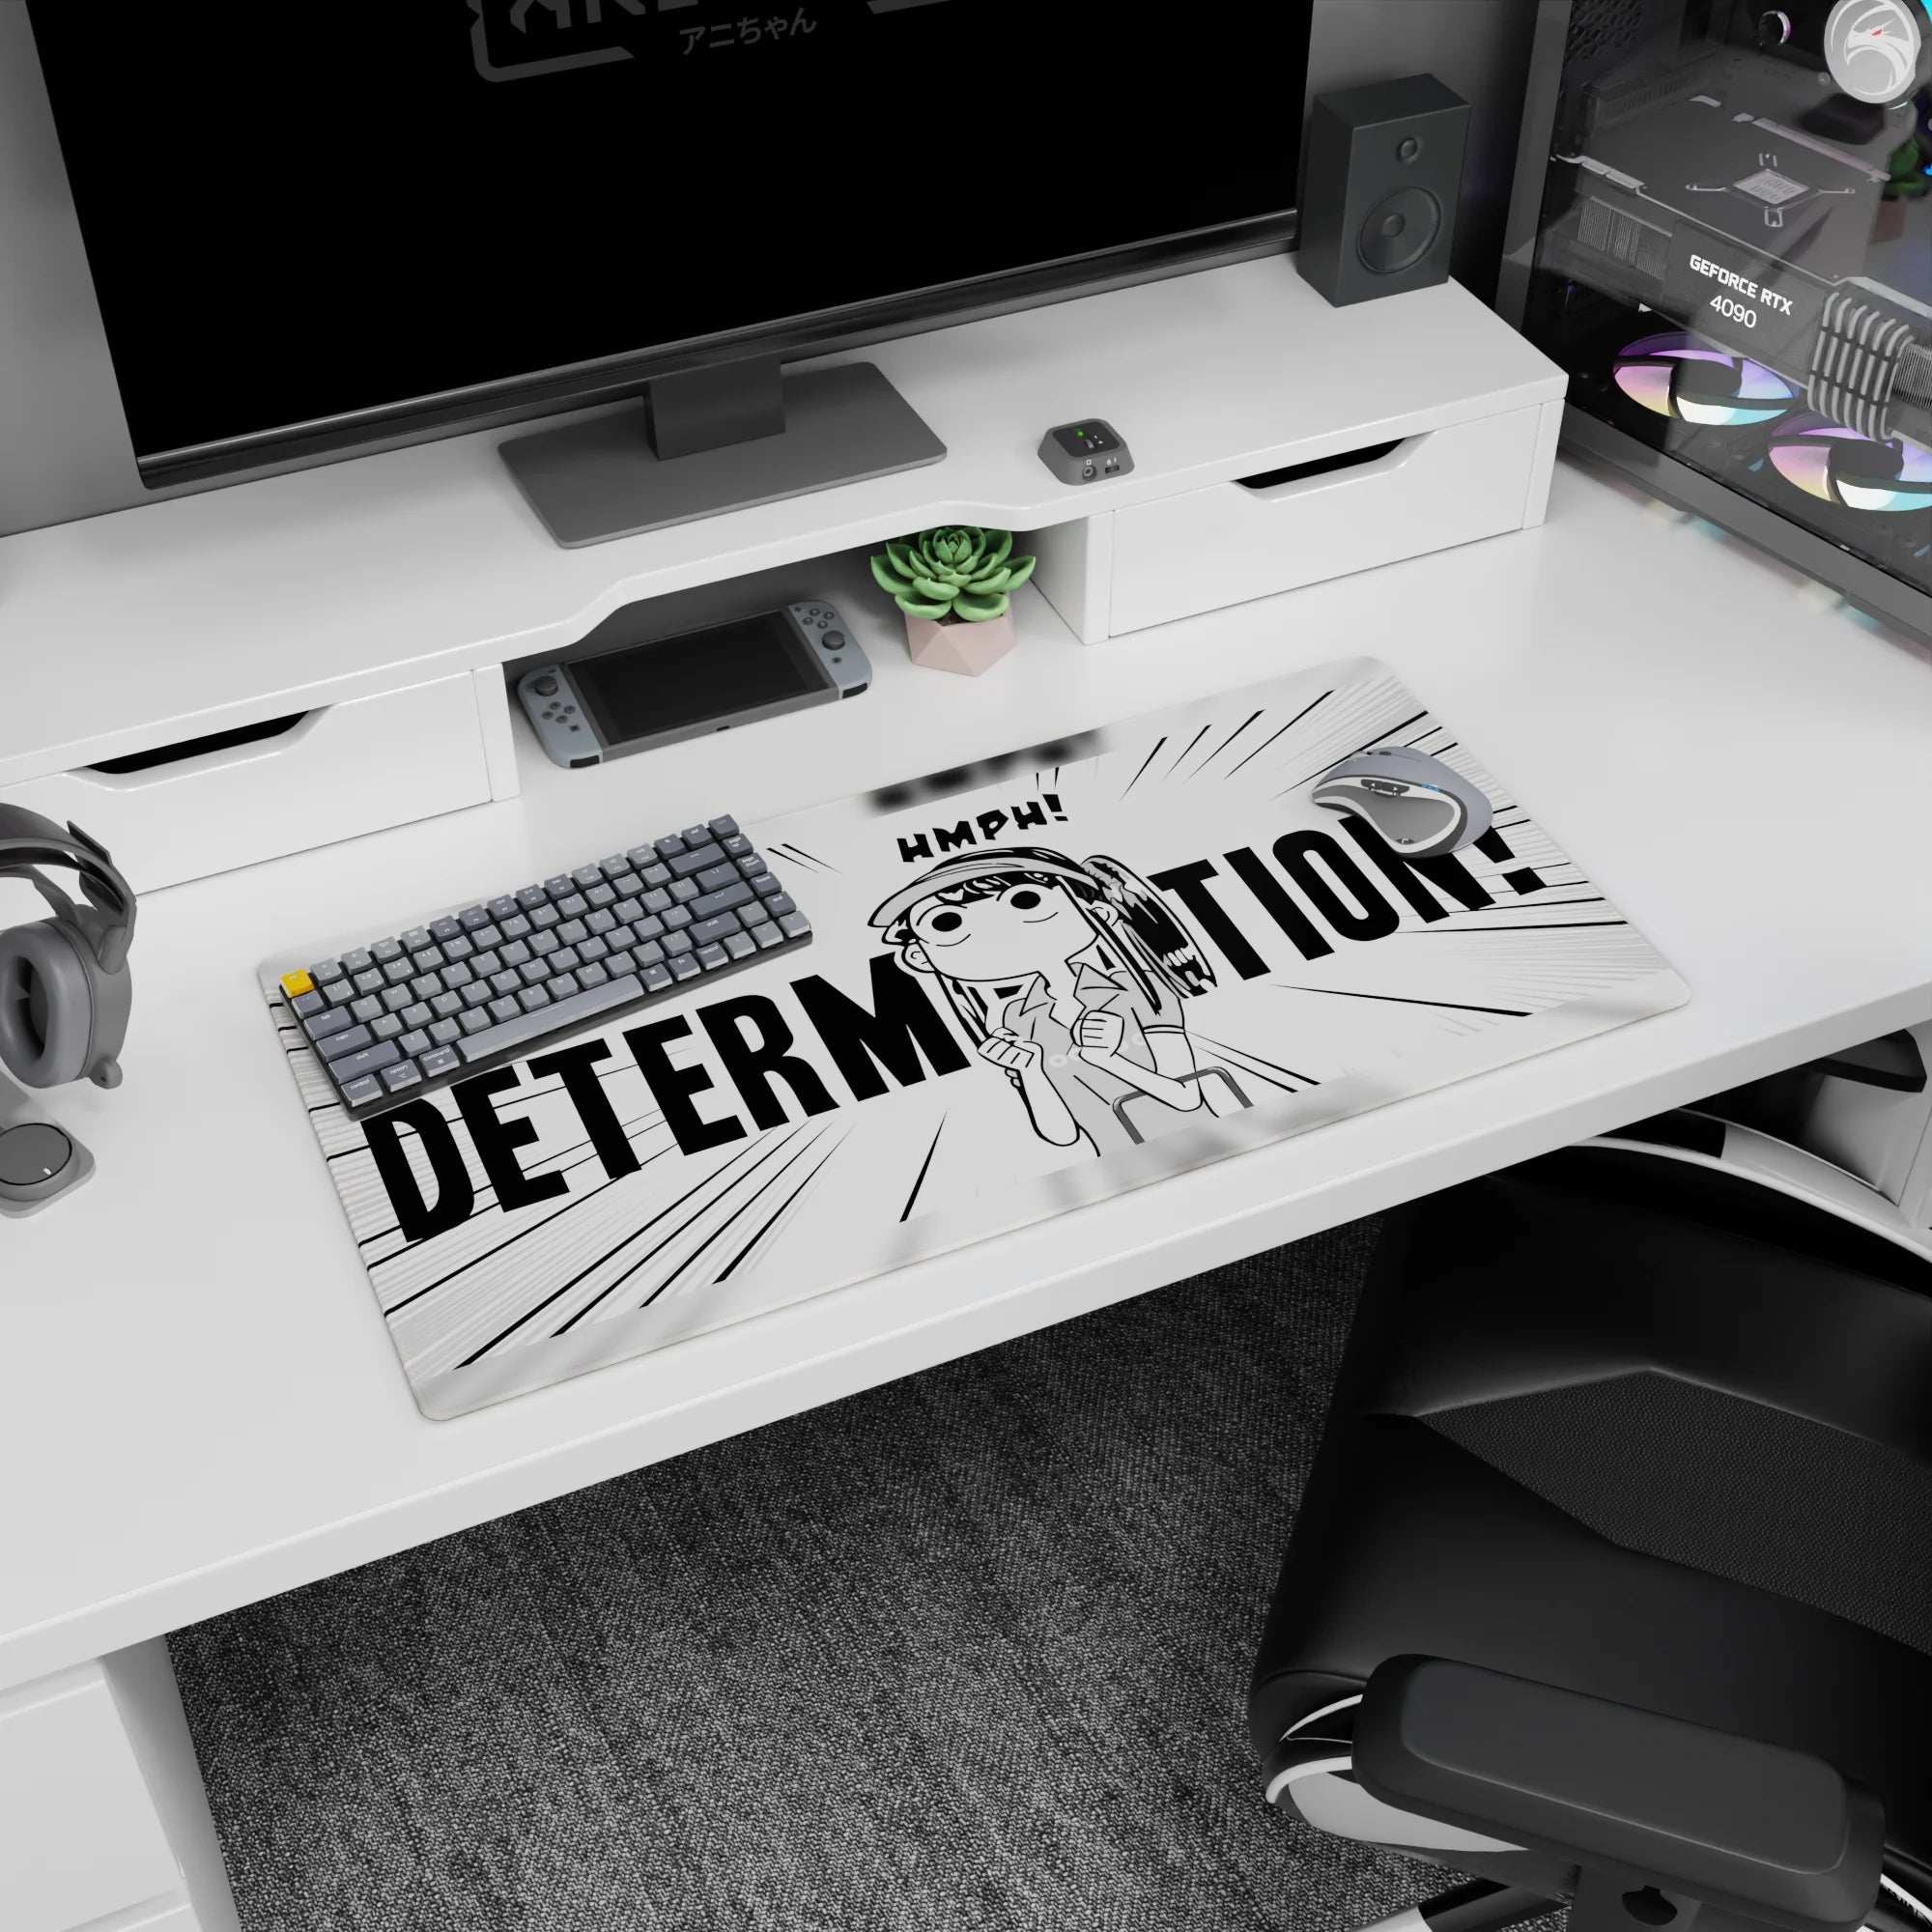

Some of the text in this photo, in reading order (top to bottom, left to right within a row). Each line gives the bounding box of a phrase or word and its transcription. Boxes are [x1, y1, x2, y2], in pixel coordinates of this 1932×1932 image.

[679, 8, 817, 55] アニちゃん
[1690, 254, 1794, 316] GEFORCE RTX
[1709, 295, 1757, 328] 4090
[897, 793, 1068, 863] HMPH!
